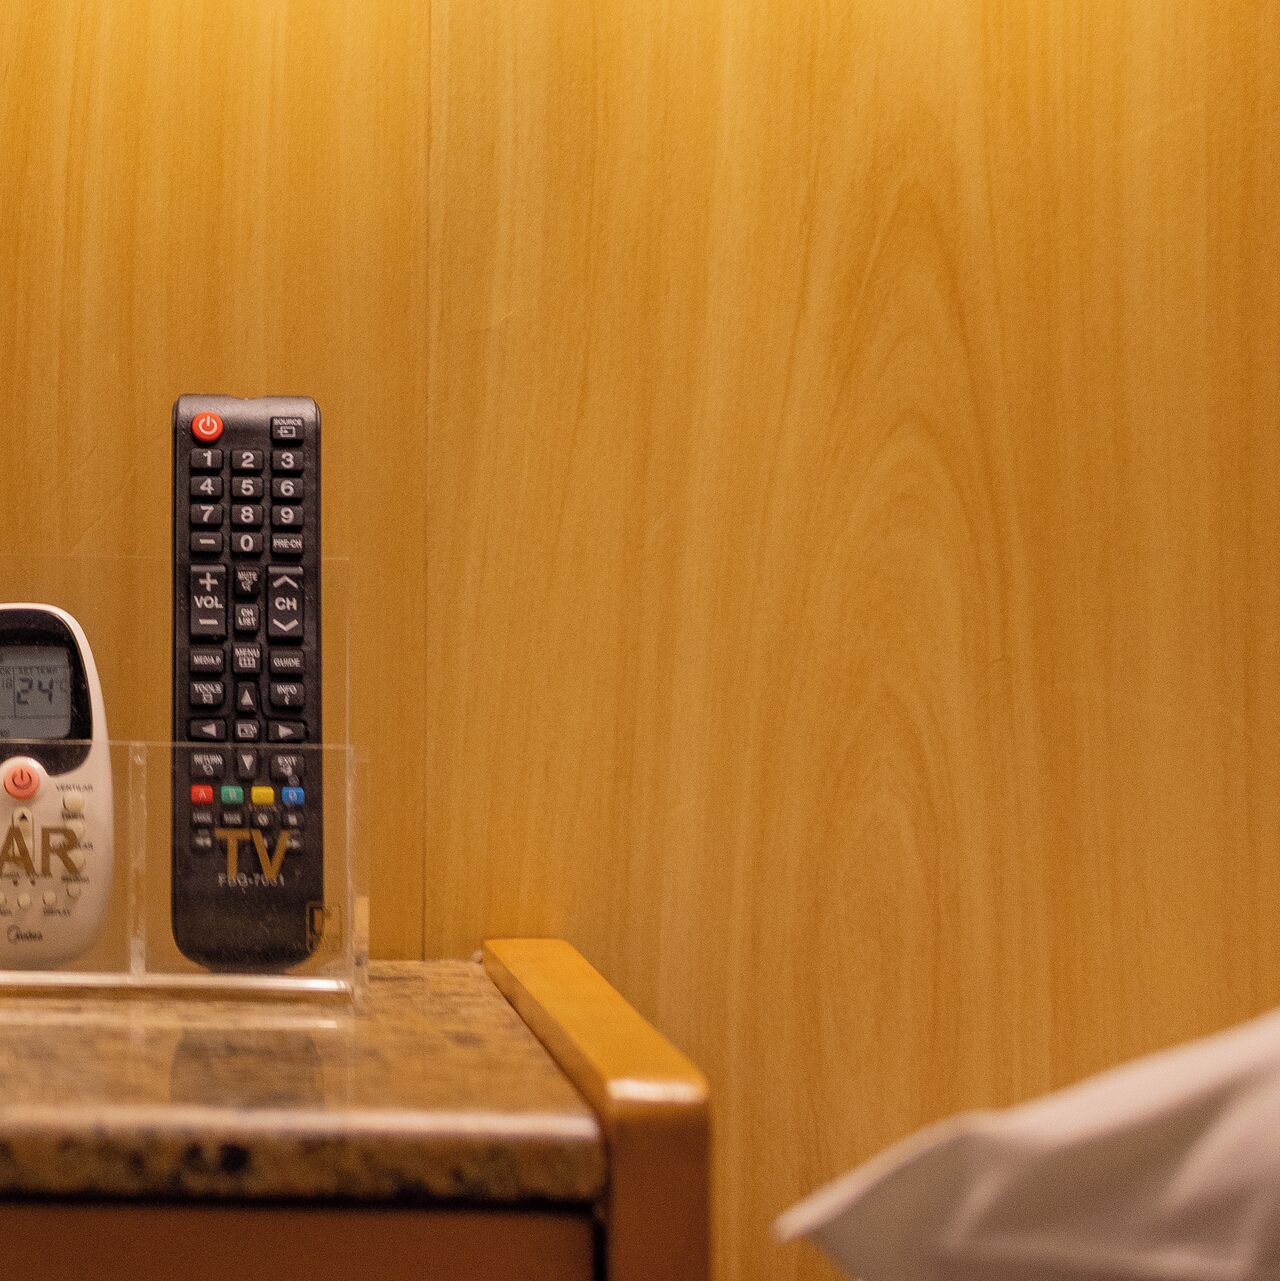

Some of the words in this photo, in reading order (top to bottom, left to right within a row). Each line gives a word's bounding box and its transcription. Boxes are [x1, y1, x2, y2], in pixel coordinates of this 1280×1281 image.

[203, 450, 212, 467] 1
[241, 451, 255, 468] 2
[281, 452, 295, 469] 3
[200, 478, 214, 495] 4
[241, 479, 254, 496] 5
[280, 480, 295, 497] 6
[200, 505, 214, 522] 7
[241, 506, 254, 523] 8
[280, 507, 294, 524] 9
[240, 534, 254, 552] 0
[238, 571, 258, 582] MUTE
[194, 596, 224, 609] VOL
[274, 597, 298, 611] CH
[240, 608, 254, 617] CH
[238, 617, 257, 627] LIST
[234, 648, 260, 658] MENU
[273, 658, 301, 668] GUIDE
[17, 677, 53, 705] 24
[193, 683, 222, 694] TOOLS
[276, 684, 298, 695] INFO
[193, 755, 223, 765] RETURN
[56, 783, 94, 792] VENTILAR
[214, 828, 291, 881] TV
